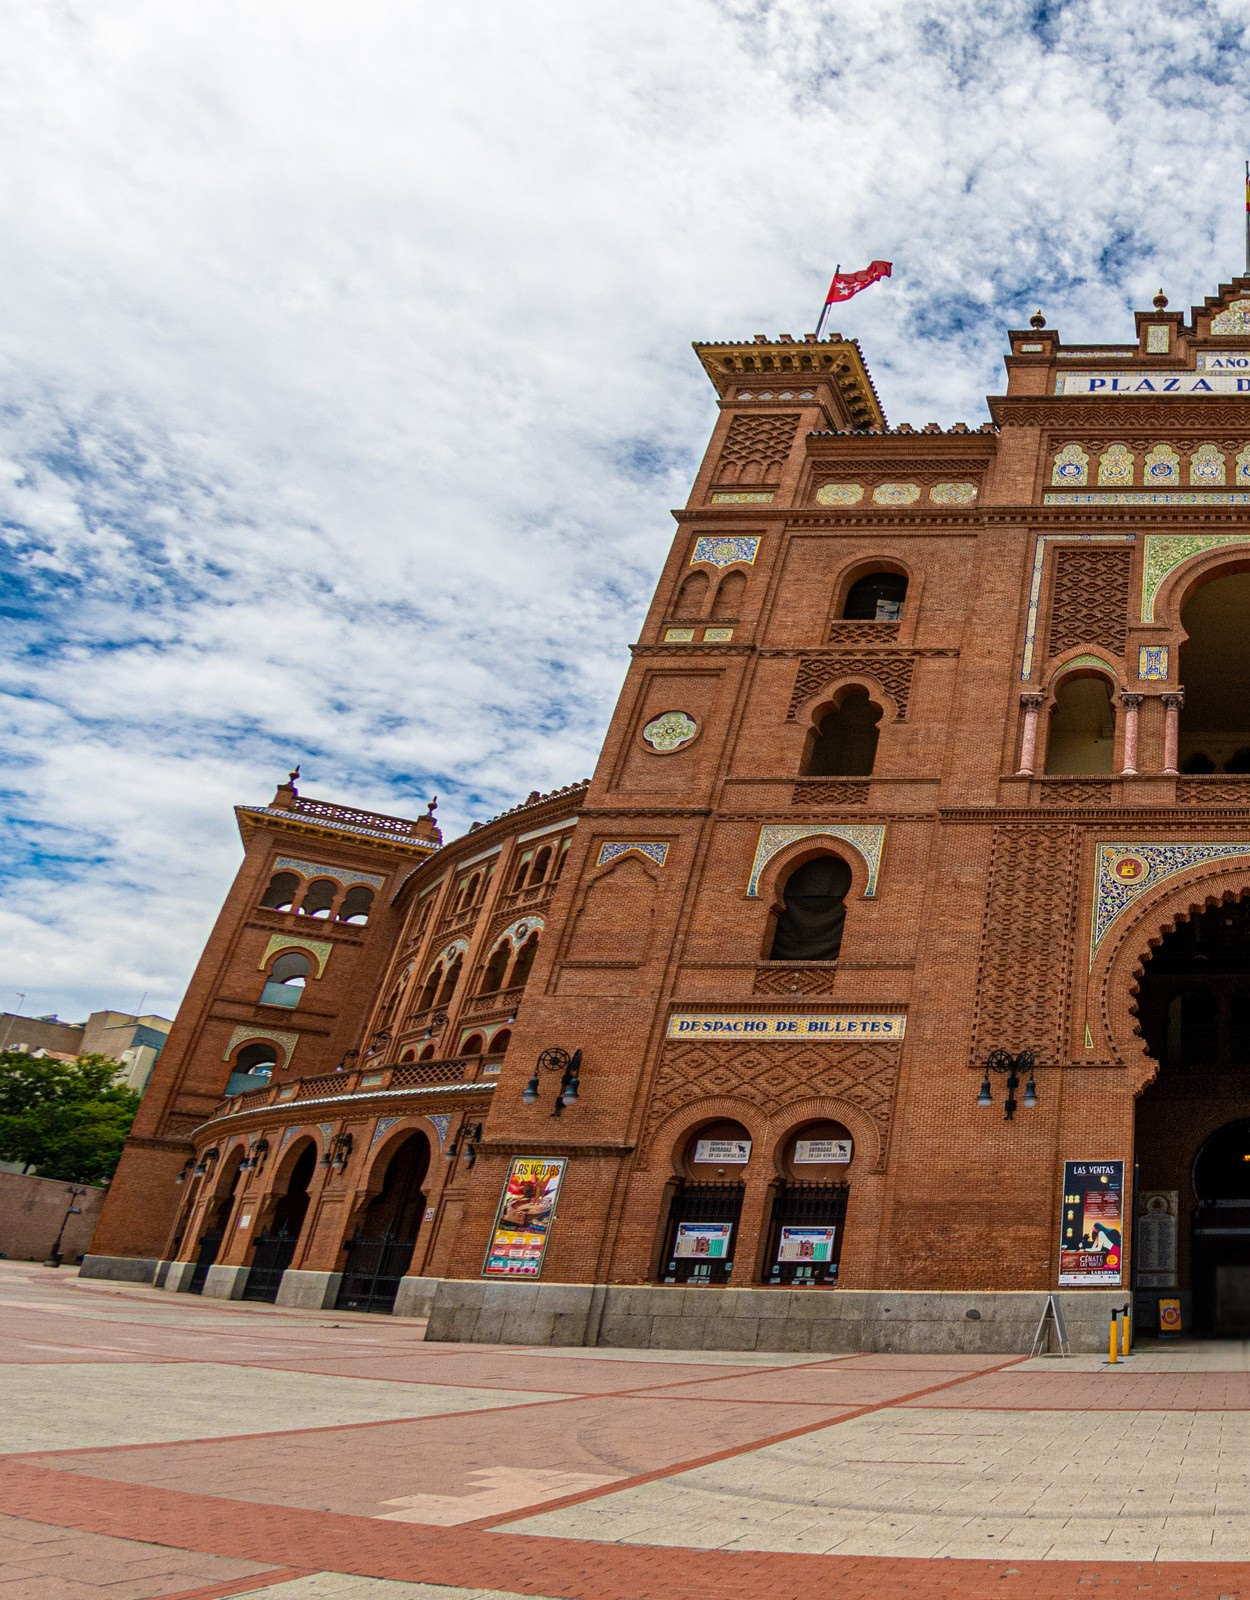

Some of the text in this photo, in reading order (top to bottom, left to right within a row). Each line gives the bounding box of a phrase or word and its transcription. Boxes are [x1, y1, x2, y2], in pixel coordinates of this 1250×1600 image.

[1211, 356, 1249, 368] AÑO
[1087, 378, 1214, 392] PLAZA
[678, 1020, 893, 1033] DESPACHO DE BILLETES
[513, 1163, 529, 1175] LAS
[1073, 1165, 1114, 1175] LAS VENTAS
